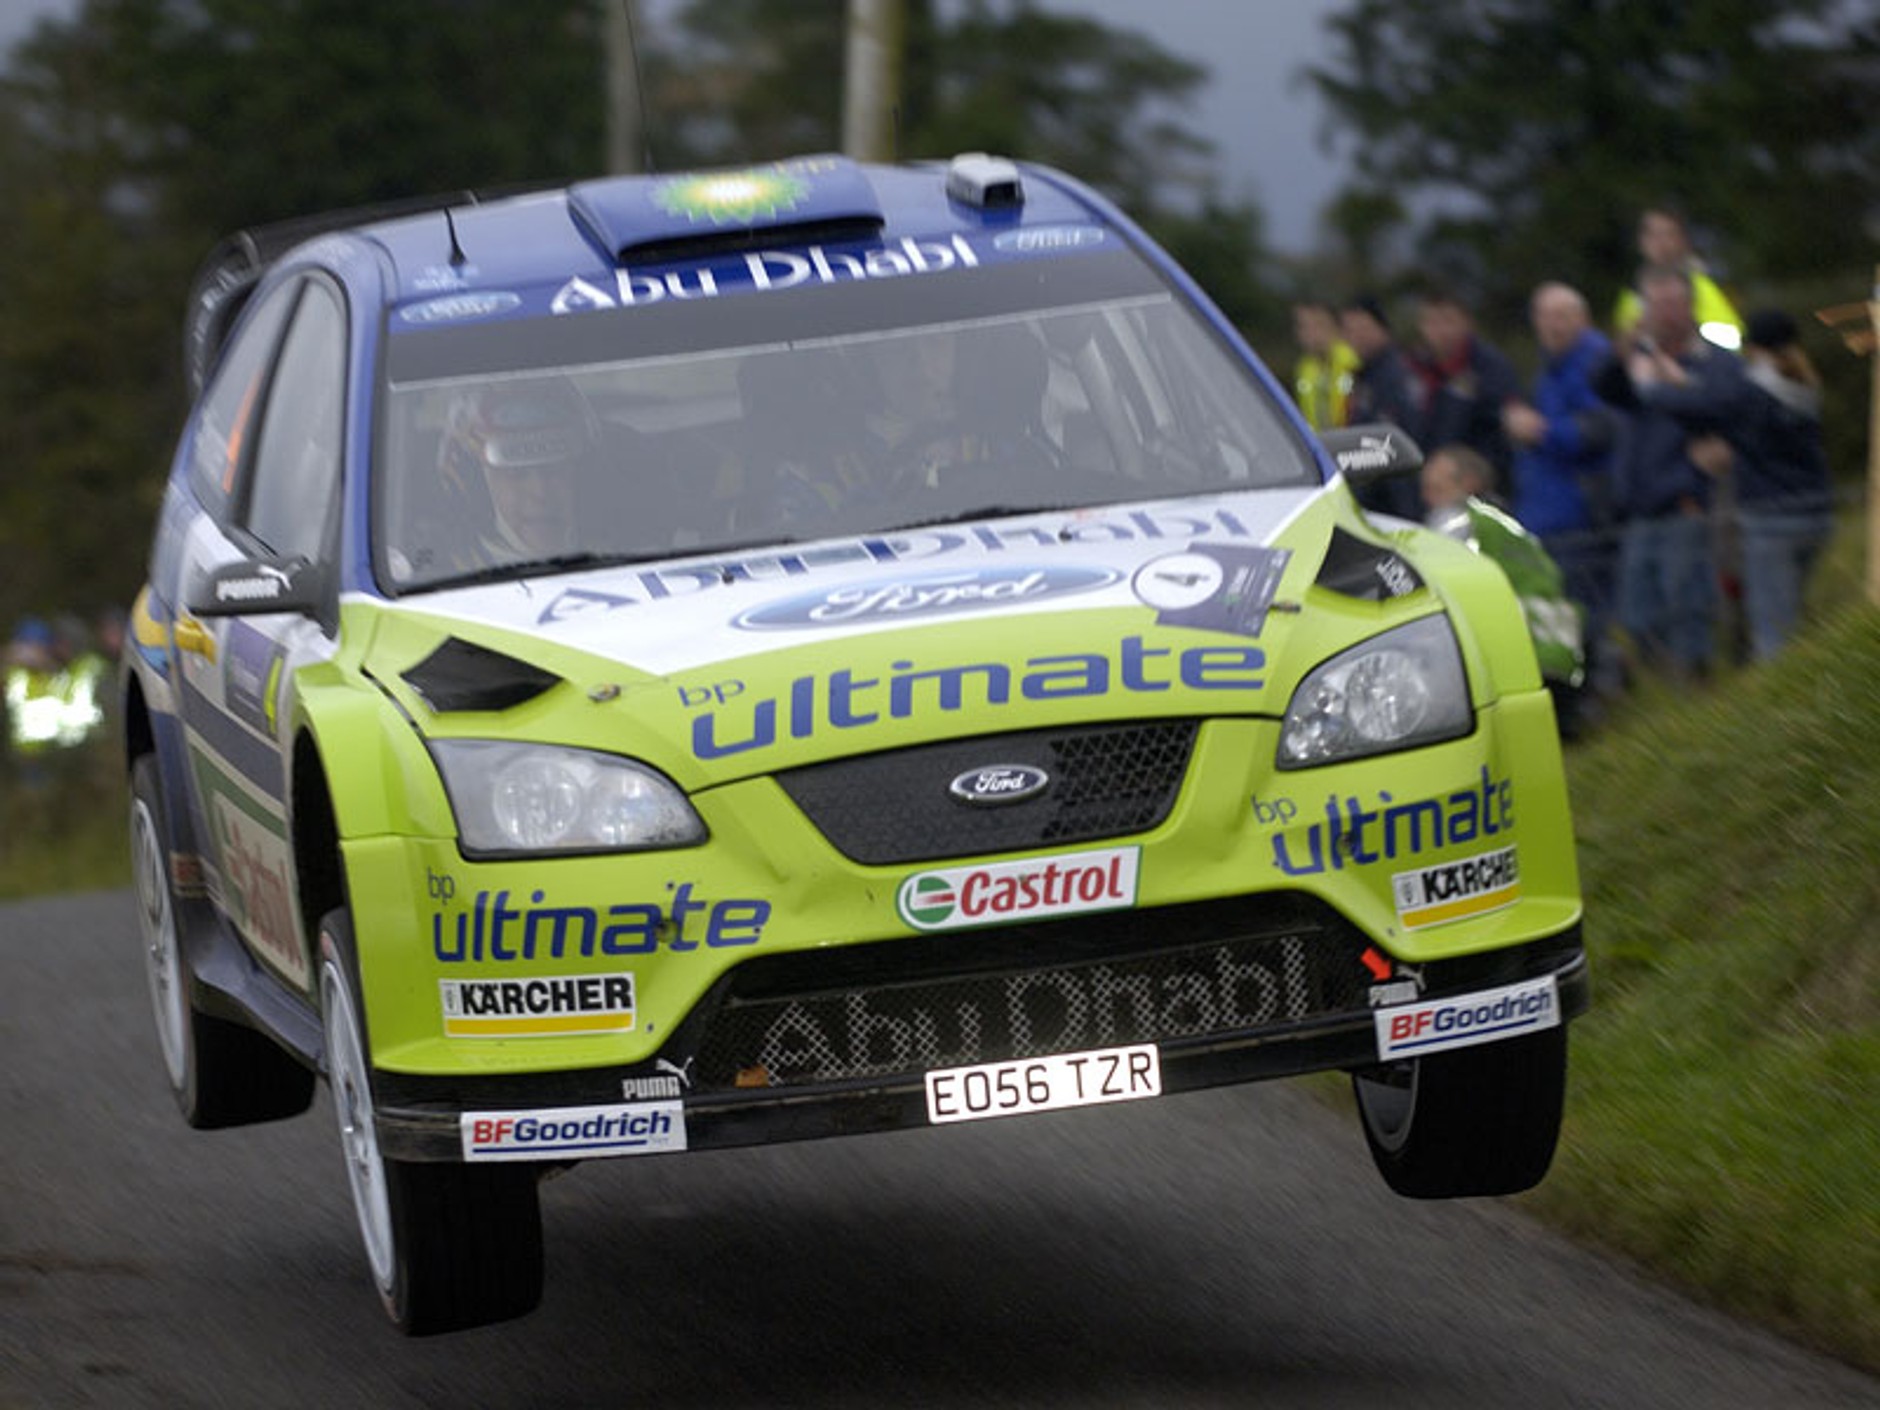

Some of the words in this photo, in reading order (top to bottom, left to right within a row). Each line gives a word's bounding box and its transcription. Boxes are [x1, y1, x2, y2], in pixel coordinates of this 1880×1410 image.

[552, 263, 718, 316] Abu
[807, 568, 1047, 622] Ford
[677, 678, 746, 709] bp
[691, 635, 1266, 761] ultimate
[974, 770, 1025, 794] Ford
[1252, 794, 1298, 825] bp
[427, 867, 454, 903] bp
[961, 856, 1125, 917] Castrol
[434, 883, 771, 963] ultimate
[460, 977, 633, 1015] KÄRCHER
[1389, 989, 1552, 1040] BFGoodrich
[762, 992, 982, 1086] Abu
[622, 1076, 681, 1100] PUMA
[1066, 1052, 1156, 1101] TZR
[473, 1110, 671, 1144] BFGoodrich
